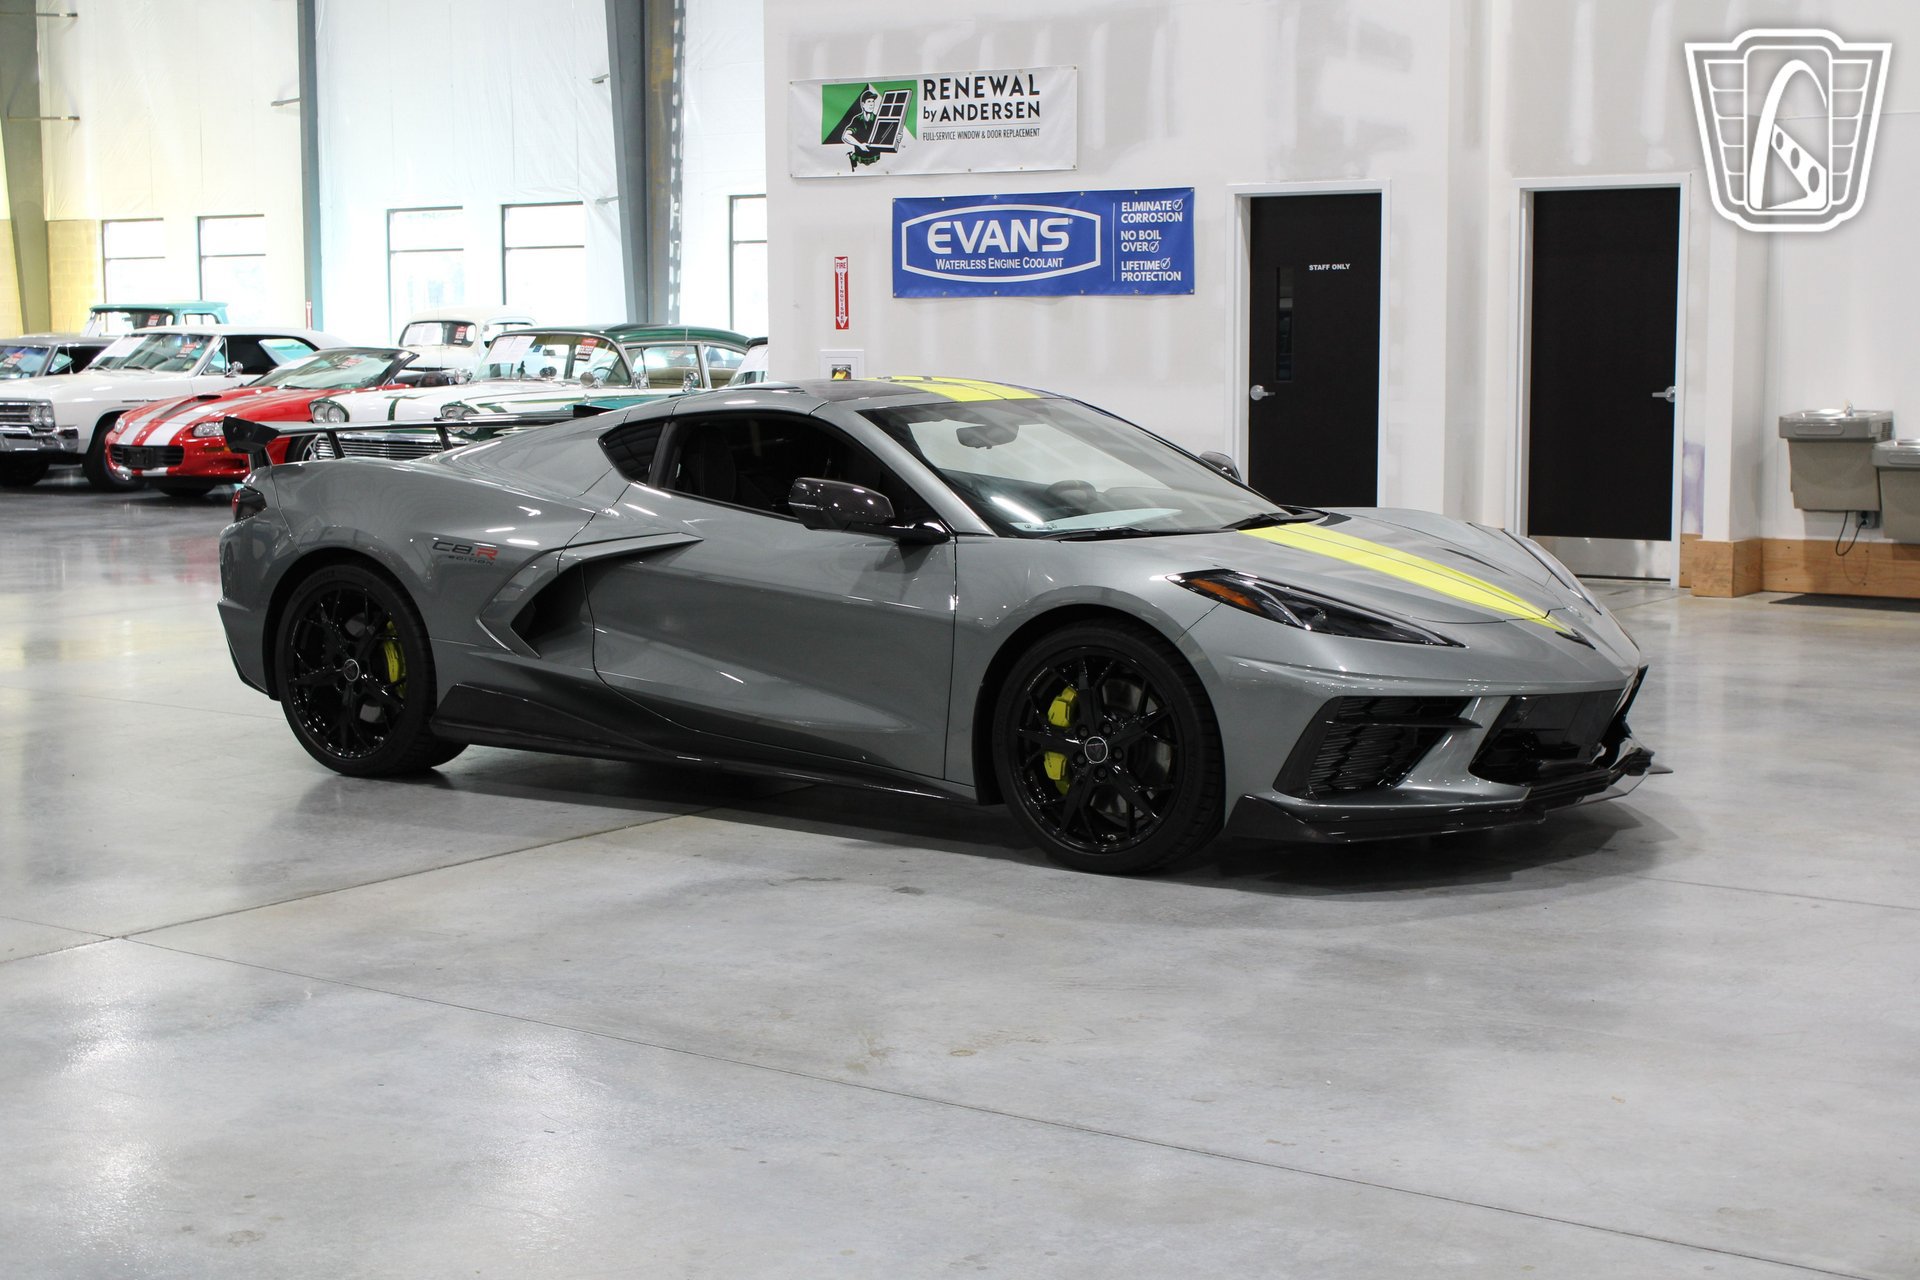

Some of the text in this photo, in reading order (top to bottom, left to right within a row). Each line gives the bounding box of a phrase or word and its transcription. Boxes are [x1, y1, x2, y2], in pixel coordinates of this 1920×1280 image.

[923, 74, 1040, 101] RENEWAL
[923, 101, 1040, 122] by ANDERSEN
[923, 128, 1040, 141] FULL-SERVICE WINDOW & DOOR REPLACEMENT
[1121, 201, 1172, 212] ELIMINATE
[1121, 212, 1183, 223] CORROSION
[927, 218, 1070, 255] EVANS
[1121, 230, 1162, 241] NO BOIL
[1121, 242, 1149, 252] OVER
[1121, 260, 1161, 271] LIFETIME
[1121, 271, 1182, 282] PROTECTION
